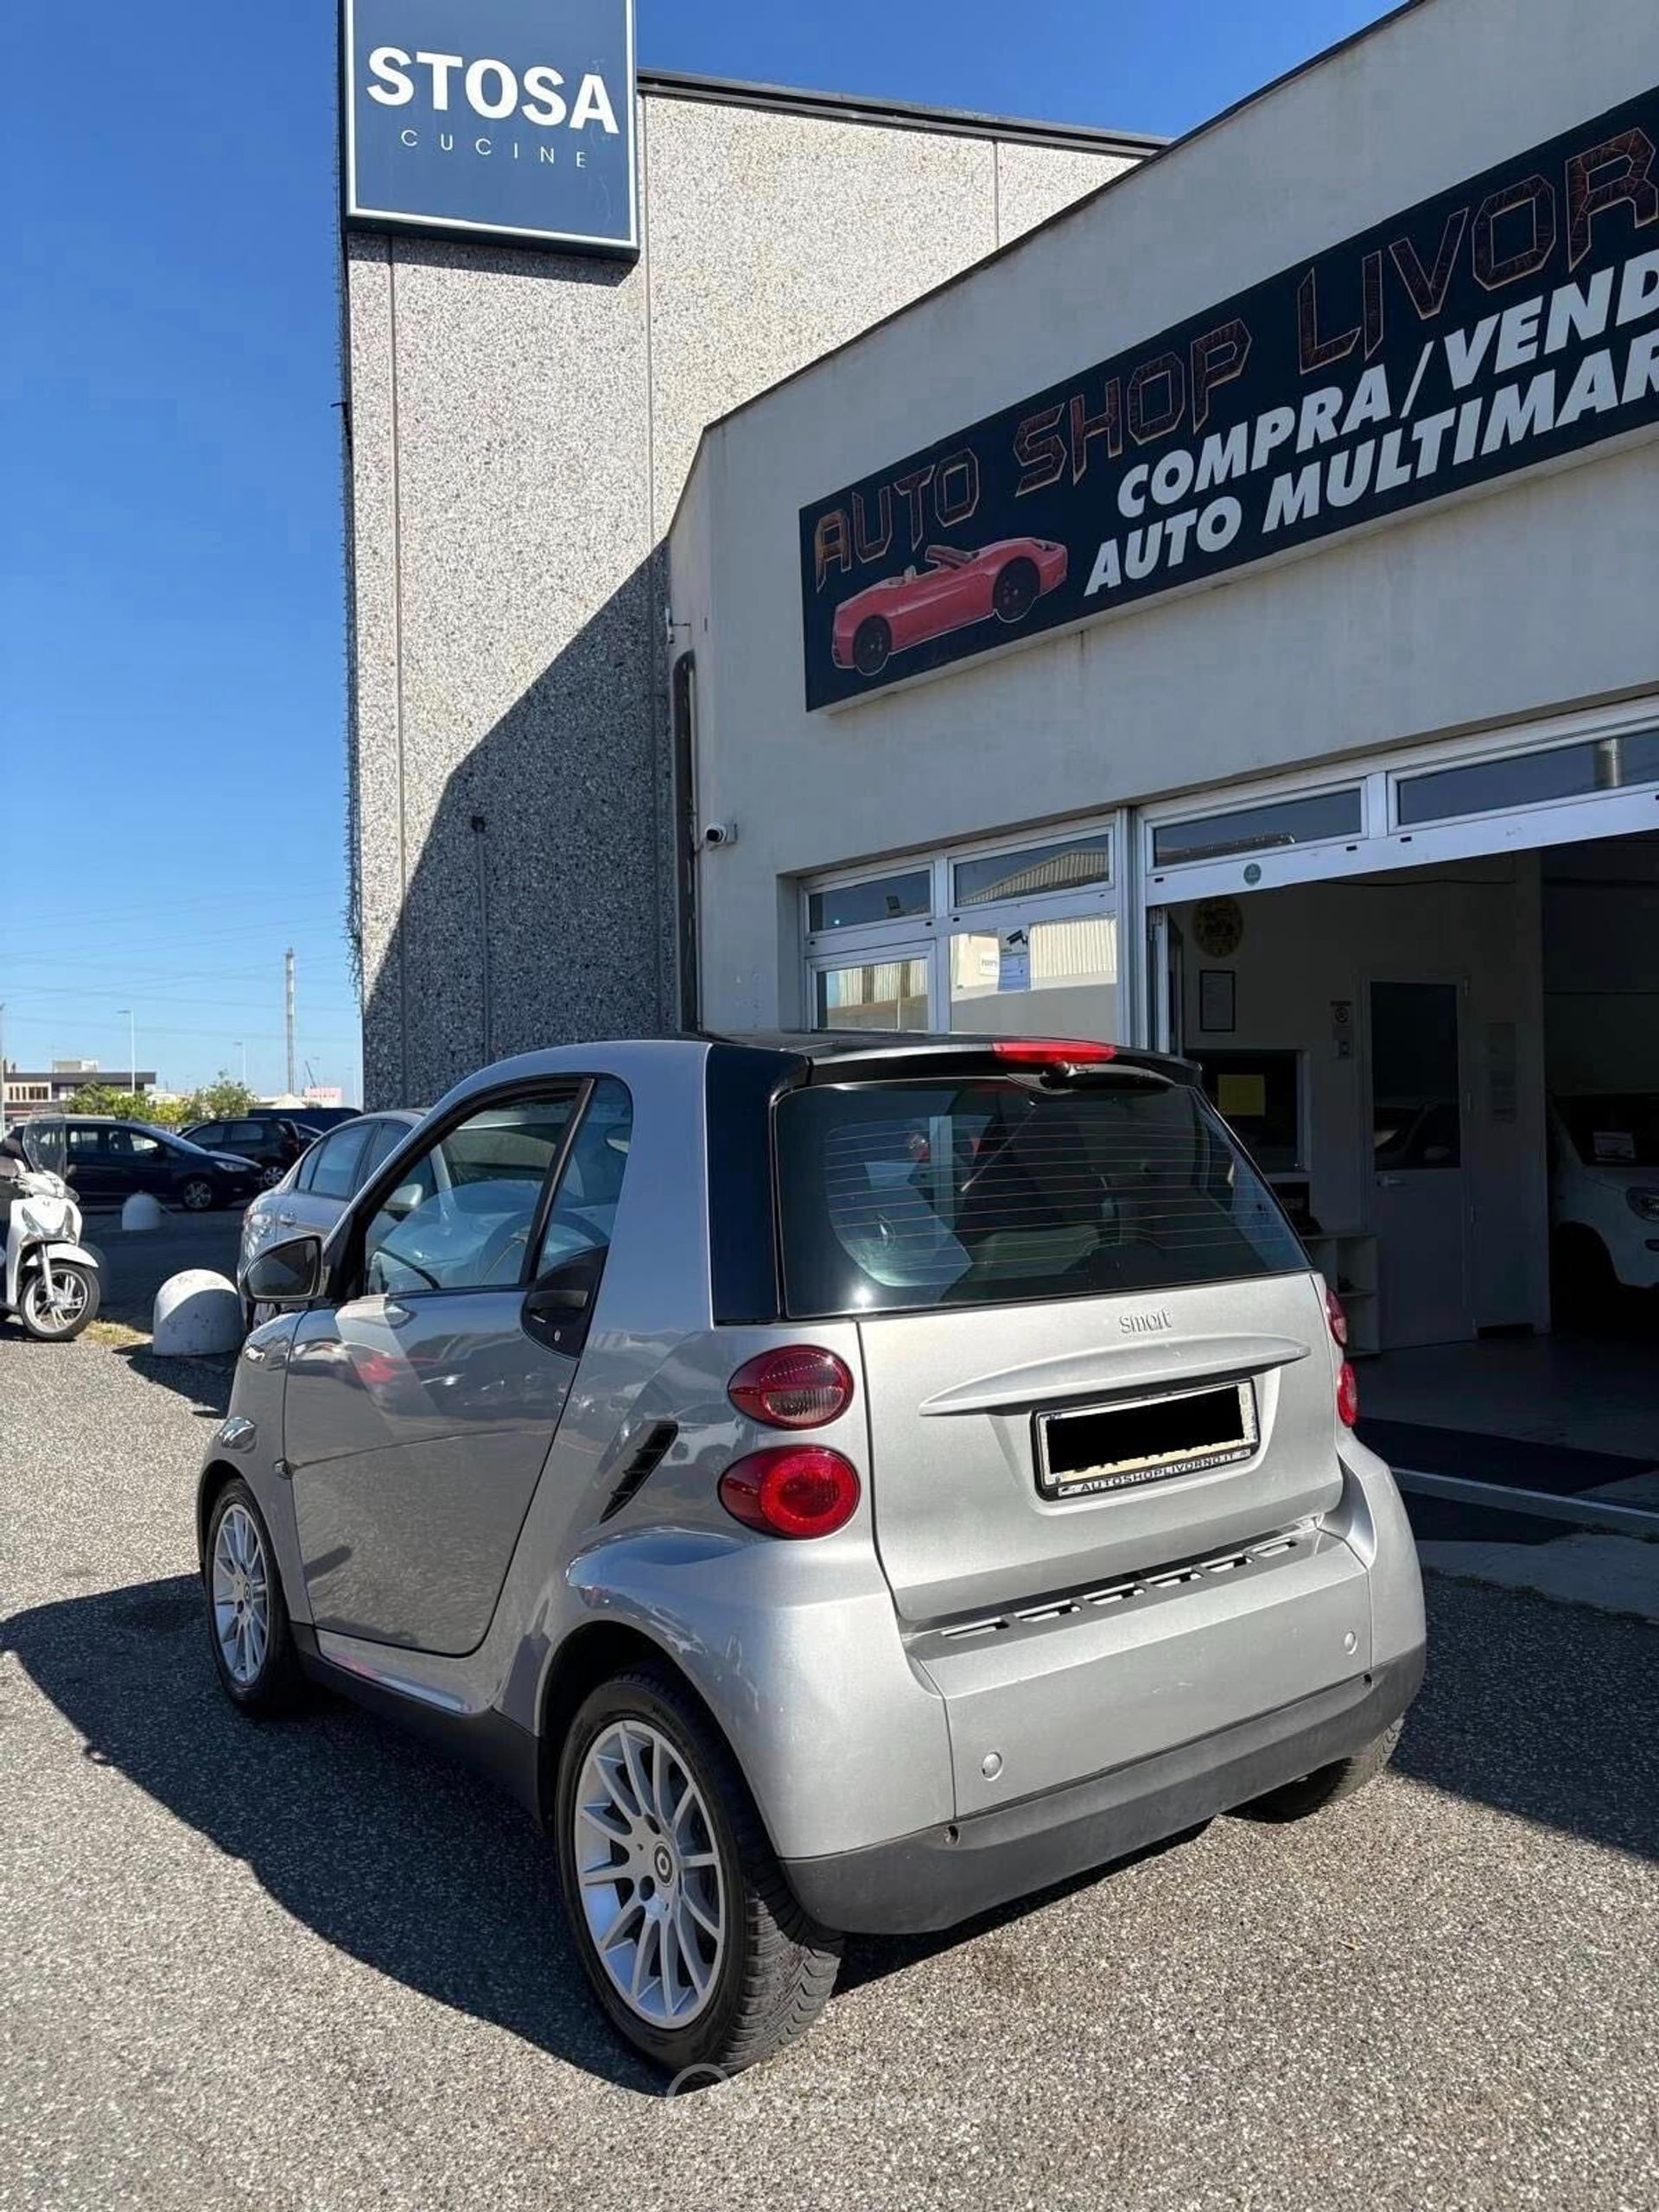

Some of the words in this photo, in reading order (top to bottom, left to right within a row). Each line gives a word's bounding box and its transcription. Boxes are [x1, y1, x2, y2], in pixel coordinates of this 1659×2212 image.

[366, 47, 620, 134] STOSA
[400, 129, 588, 168] CUCINE
[816, 447, 980, 593] AUTO
[1013, 318, 1253, 497] SHOP
[1298, 127, 1658, 375] LIVOR
[1084, 496, 1243, 597] AUTO
[1118, 1307, 1173, 1333] smart
